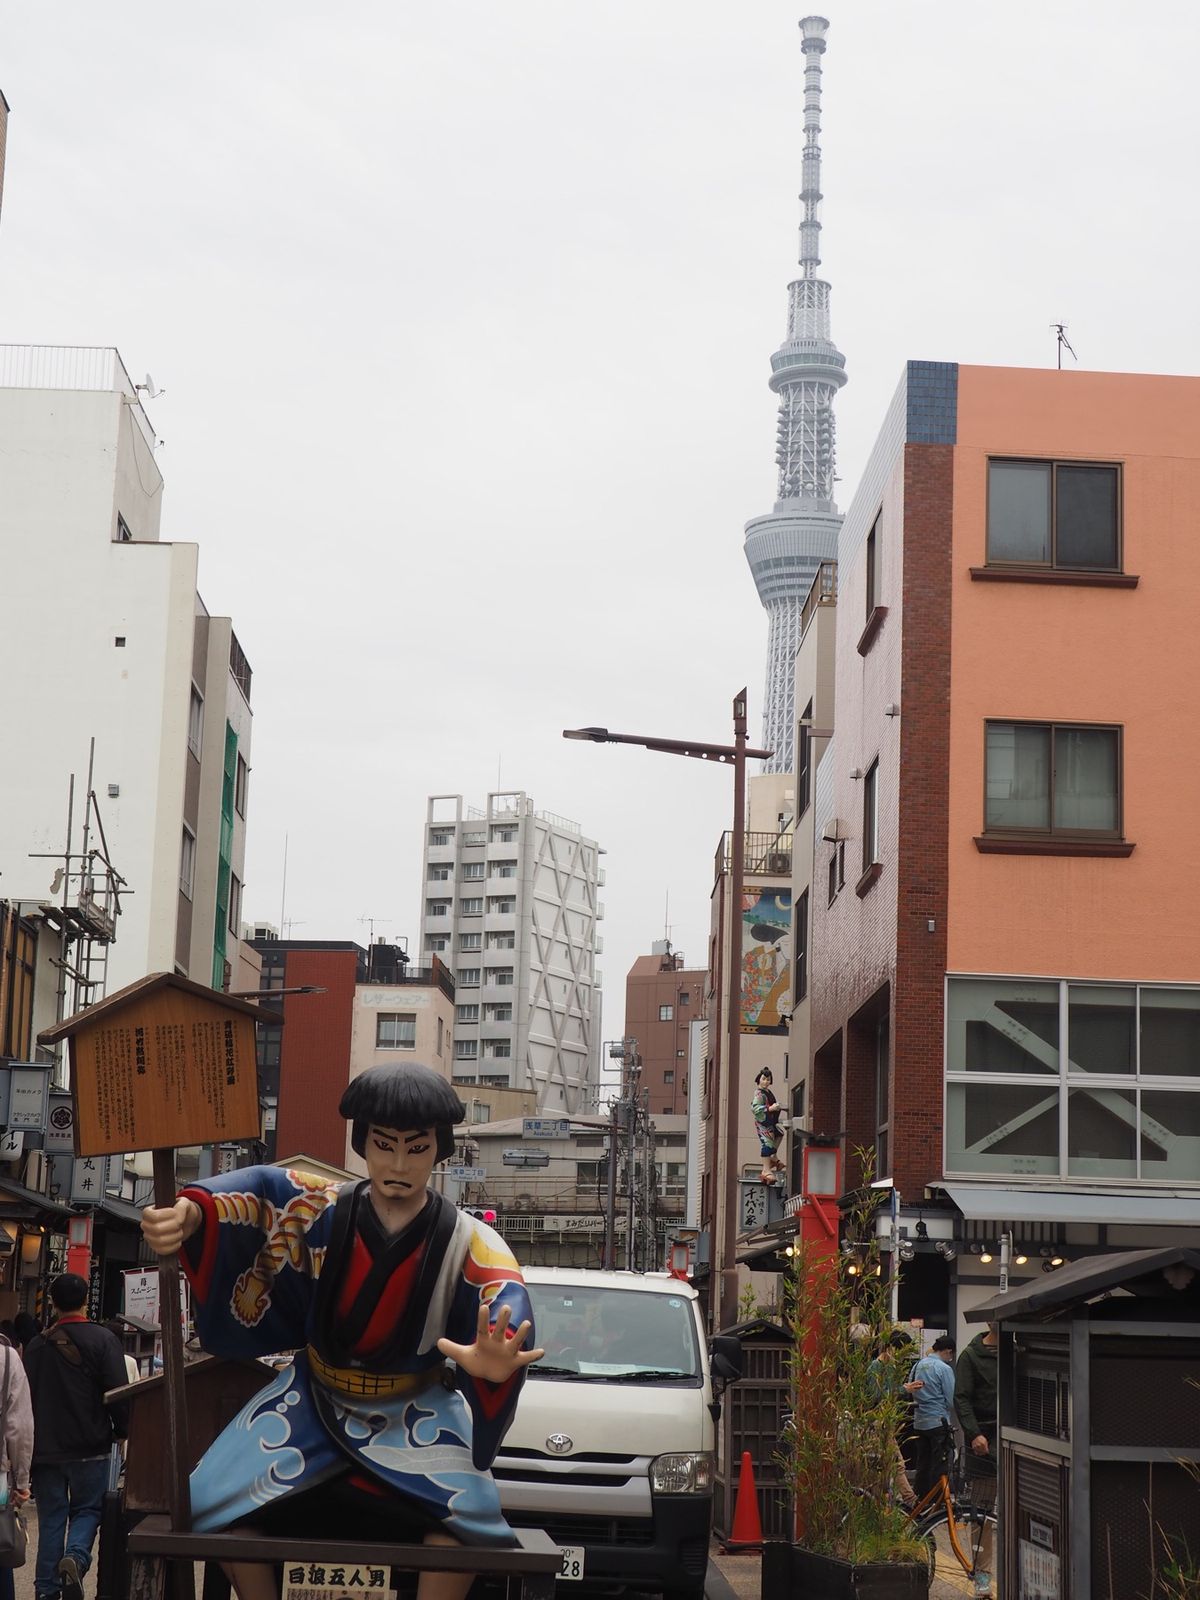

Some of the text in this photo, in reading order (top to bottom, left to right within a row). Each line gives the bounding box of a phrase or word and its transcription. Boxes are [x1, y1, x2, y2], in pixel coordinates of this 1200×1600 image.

[525, 1121, 568, 1131] 浅草二丁目
[81, 1157, 96, 1191] 丸井
[452, 1168, 484, 1176] 浅草二丁目
[288, 1565, 385, 1587] 白浪五人男
